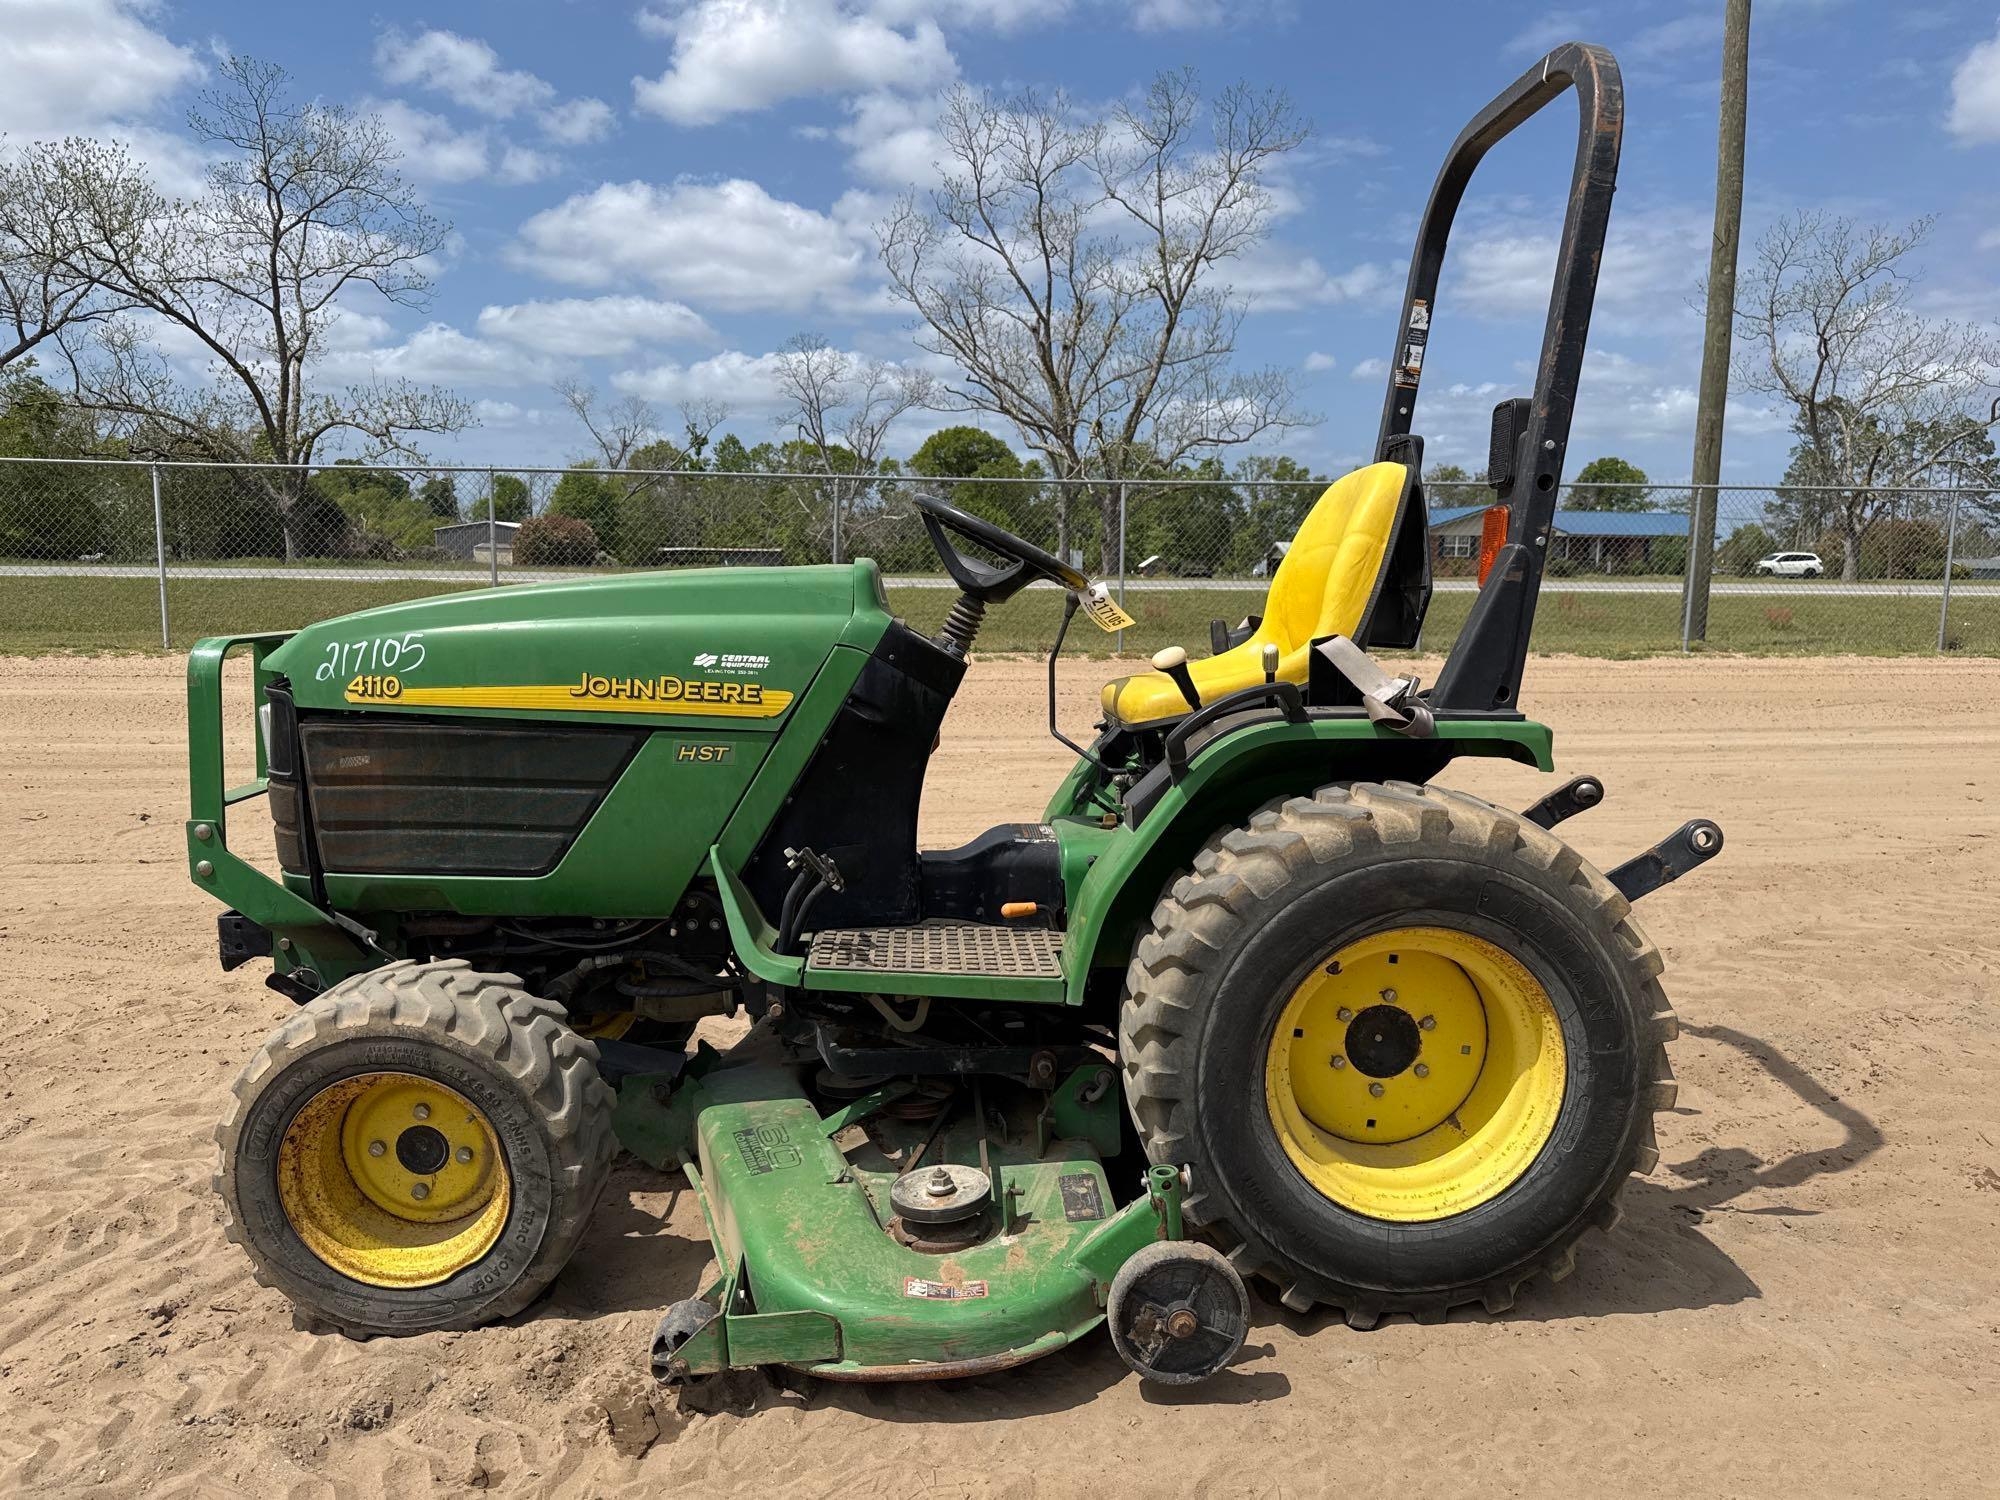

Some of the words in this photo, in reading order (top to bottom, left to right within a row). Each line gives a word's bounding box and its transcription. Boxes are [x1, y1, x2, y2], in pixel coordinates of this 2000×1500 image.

[1092, 597, 1125, 627] 217105
[316, 633, 425, 681] 217105
[721, 654, 770, 663] CENTRAL
[347, 675, 402, 698] 4110
[570, 672, 655, 700] JOHN
[659, 675, 763, 704] DEERE
[677, 744, 730, 763] HST
[757, 1122, 802, 1170] 60
[516, 1210, 536, 1243] TRAC
